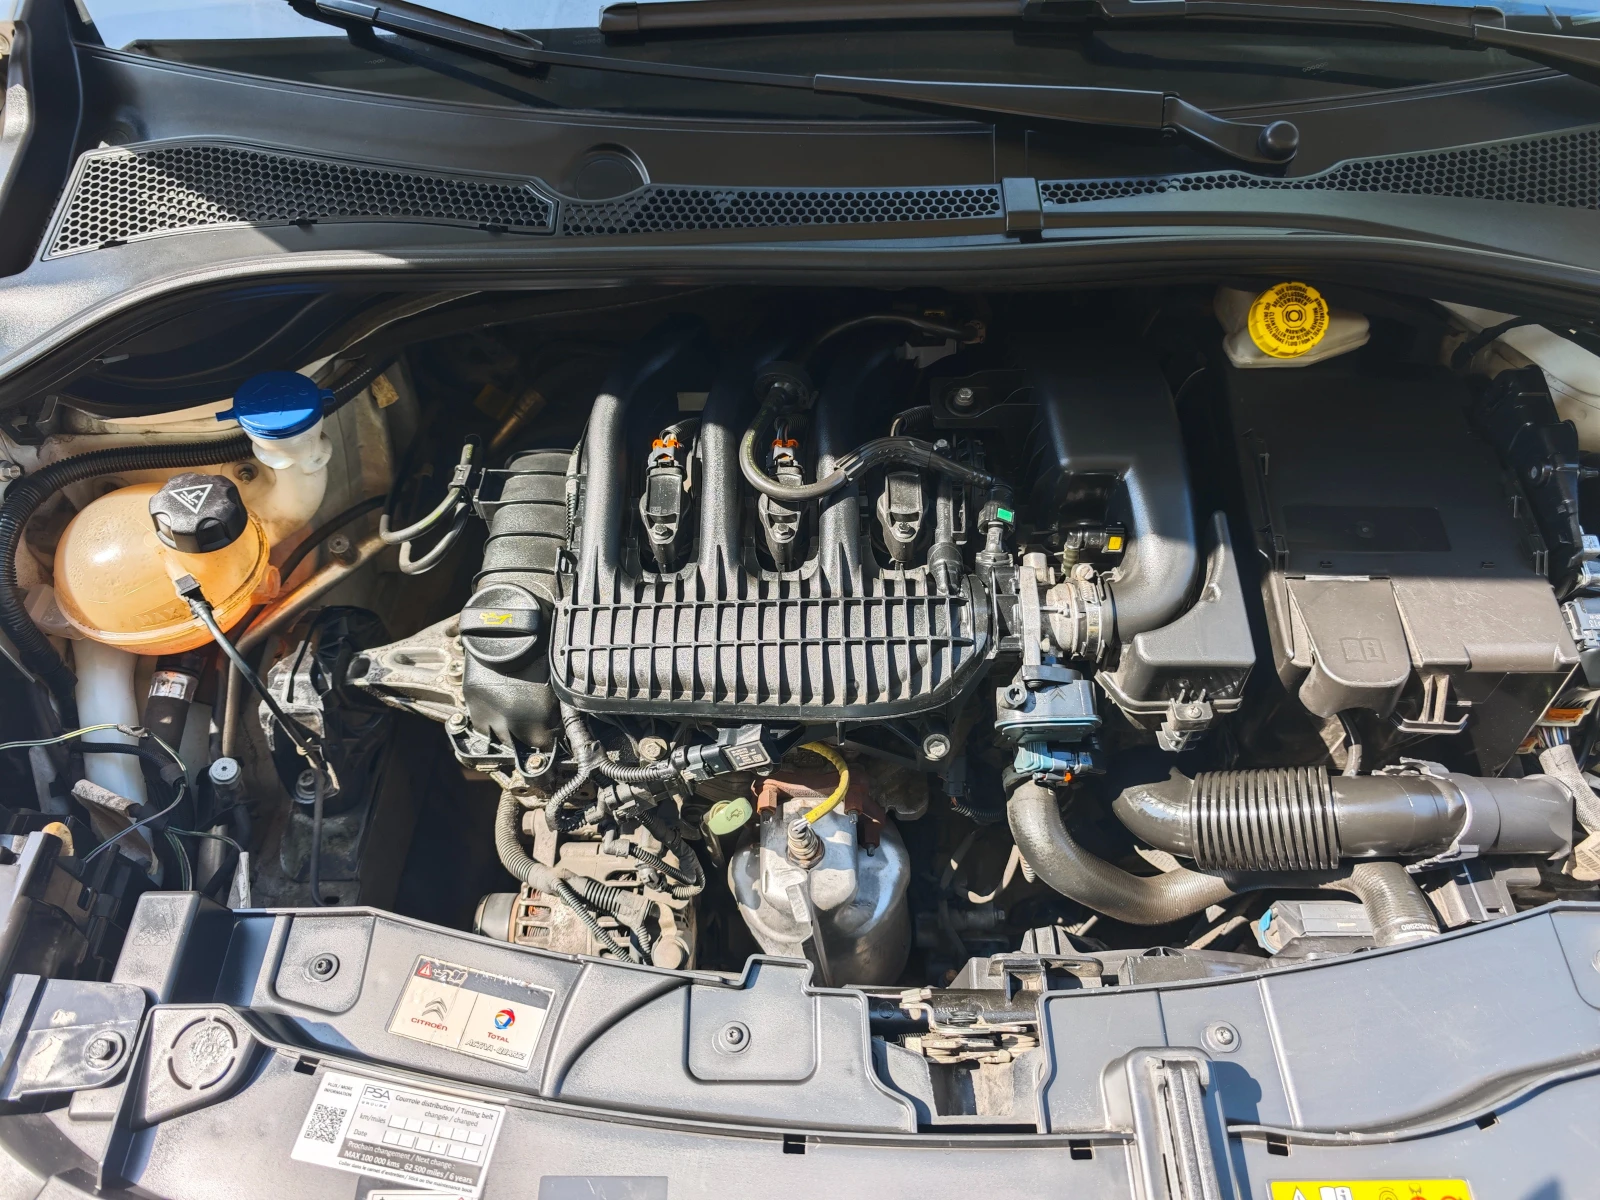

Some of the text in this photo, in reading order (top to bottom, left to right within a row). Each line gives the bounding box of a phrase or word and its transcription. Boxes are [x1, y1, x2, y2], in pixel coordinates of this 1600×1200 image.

[487, 1031, 510, 1043] TOTAL
[465, 1039, 494, 1052] ACTIVA
[496, 1046, 527, 1060] QUARTZ
[324, 1088, 353, 1097] INFORMATION
[364, 1086, 390, 1100] PSA
[421, 1100, 455, 1112] distribution
[461, 1108, 480, 1119] Timing
[481, 1112, 494, 1121] belt
[360, 1113, 386, 1124] km/miles
[453, 1117, 479, 1127] changed
[353, 1129, 368, 1137] Date
[348, 1141, 374, 1152] Prochain
[374, 1147, 411, 1160] changement
[415, 1155, 430, 1165] Next
[343, 1150, 360, 1160] MAX
[361, 1153, 373, 1163] 100
[373, 1156, 387, 1165] 000
[413, 1164, 427, 1174] 500
[426, 1169, 444, 1178] miles
[455, 1175, 473, 1184] years
[433, 1182, 460, 1191] maintenance
